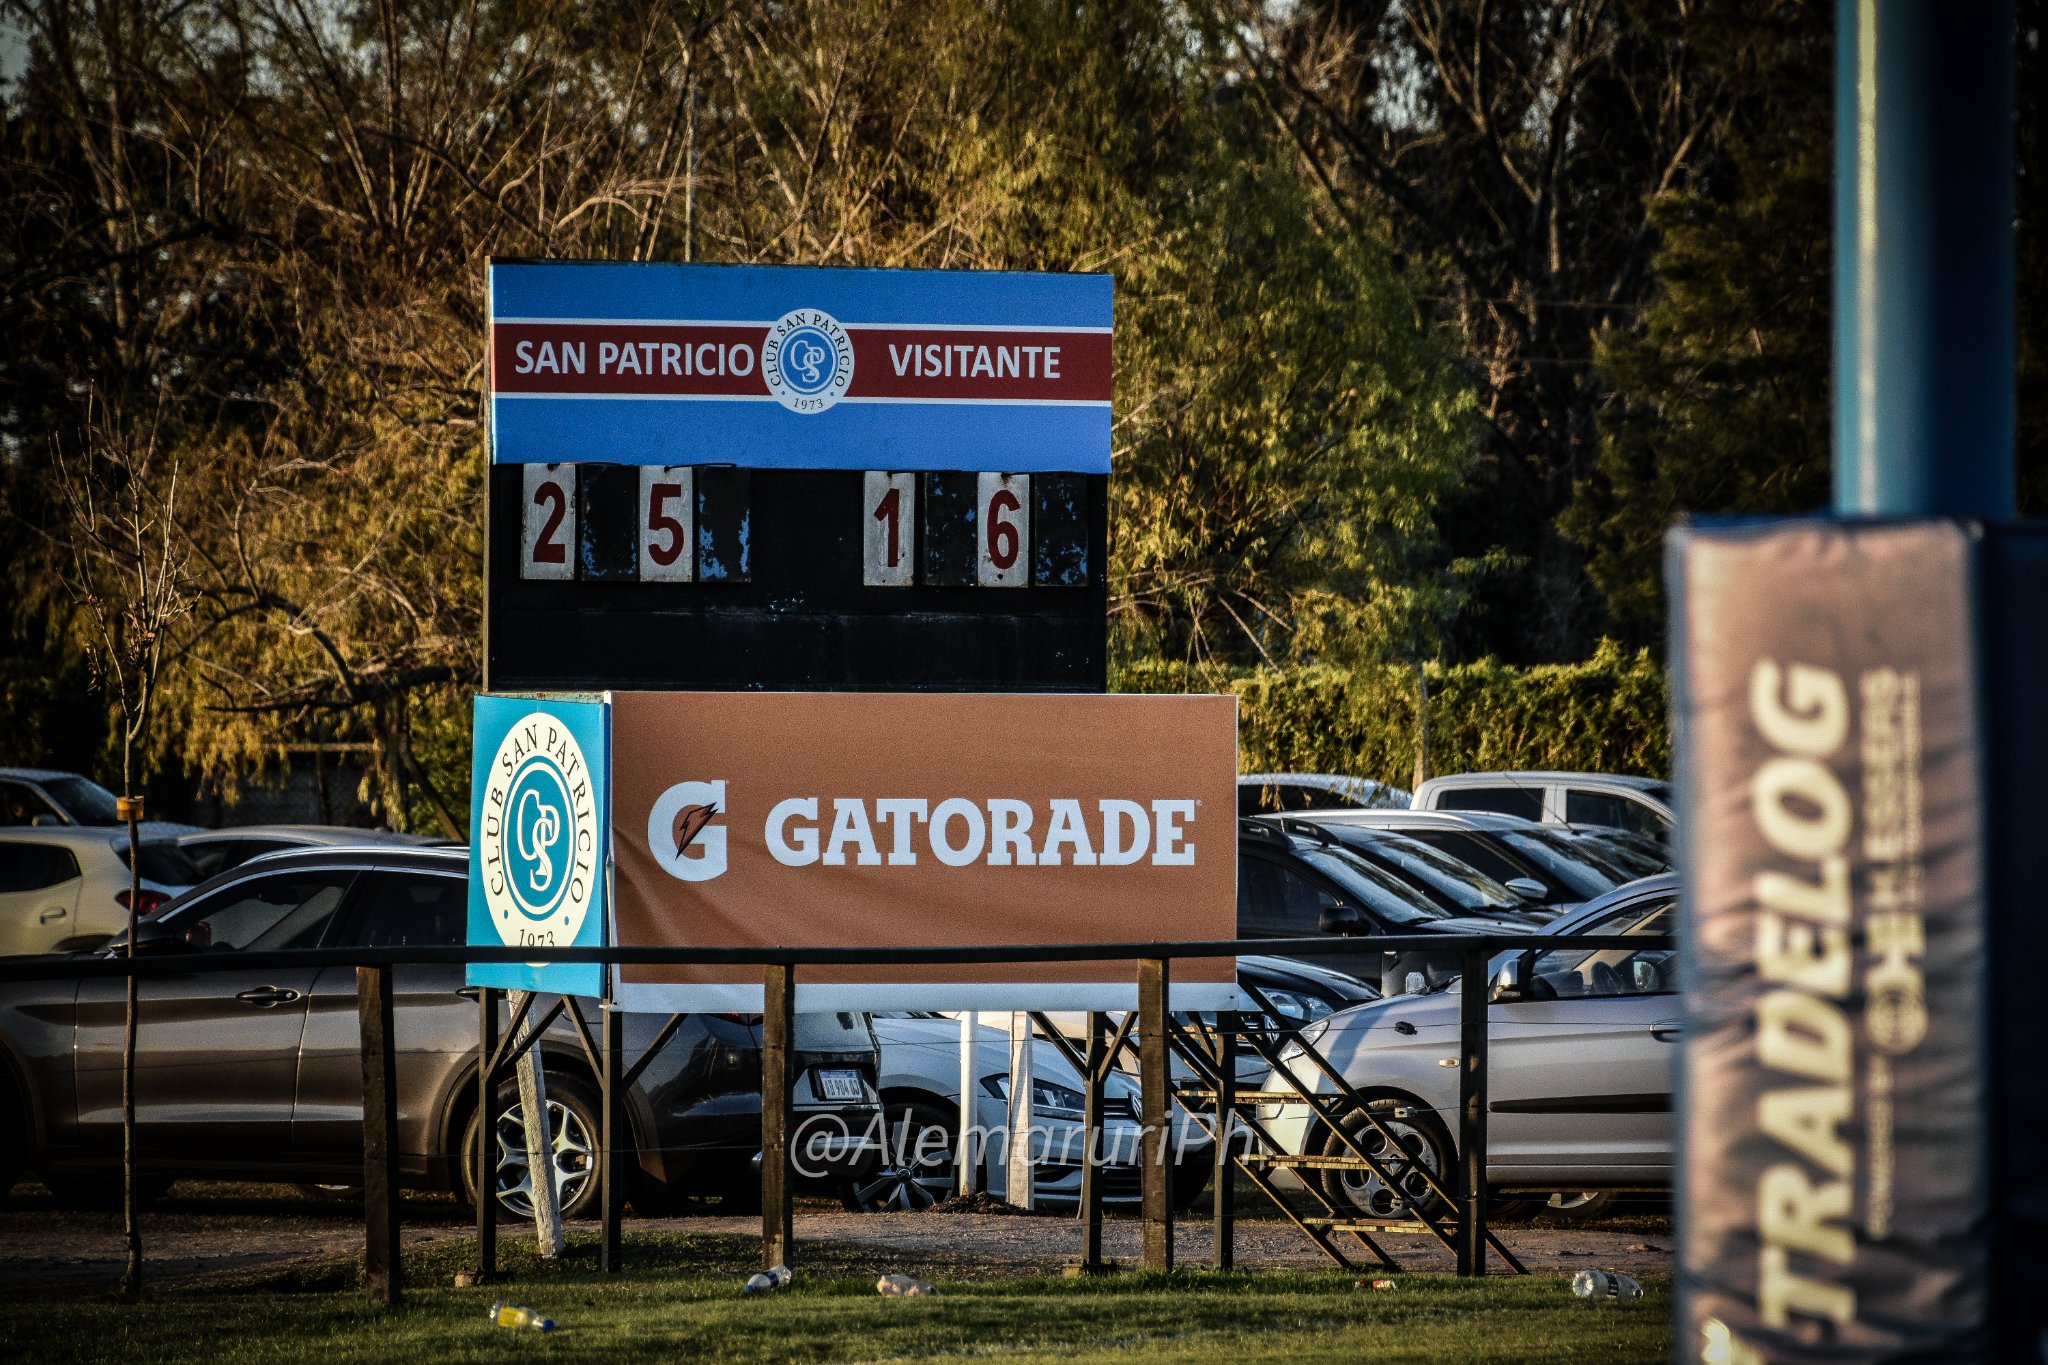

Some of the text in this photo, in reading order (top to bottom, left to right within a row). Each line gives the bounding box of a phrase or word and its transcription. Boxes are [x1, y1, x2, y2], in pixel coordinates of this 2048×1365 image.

[514, 340, 755, 378] SAN PATRICIO
[766, 312, 850, 388] CLUB SAN PATRICIO
[889, 344, 1061, 380] VISITANTE
[793, 398, 824, 410] 1973
[532, 481, 685, 566] 2 5
[873, 488, 1020, 570] 1 6
[486, 724, 591, 905] CLUB SAN PATRICIO
[647, 779, 728, 882] G
[764, 796, 1195, 867] GATORADE
[1751, 657, 1857, 1328] TRADELOG
